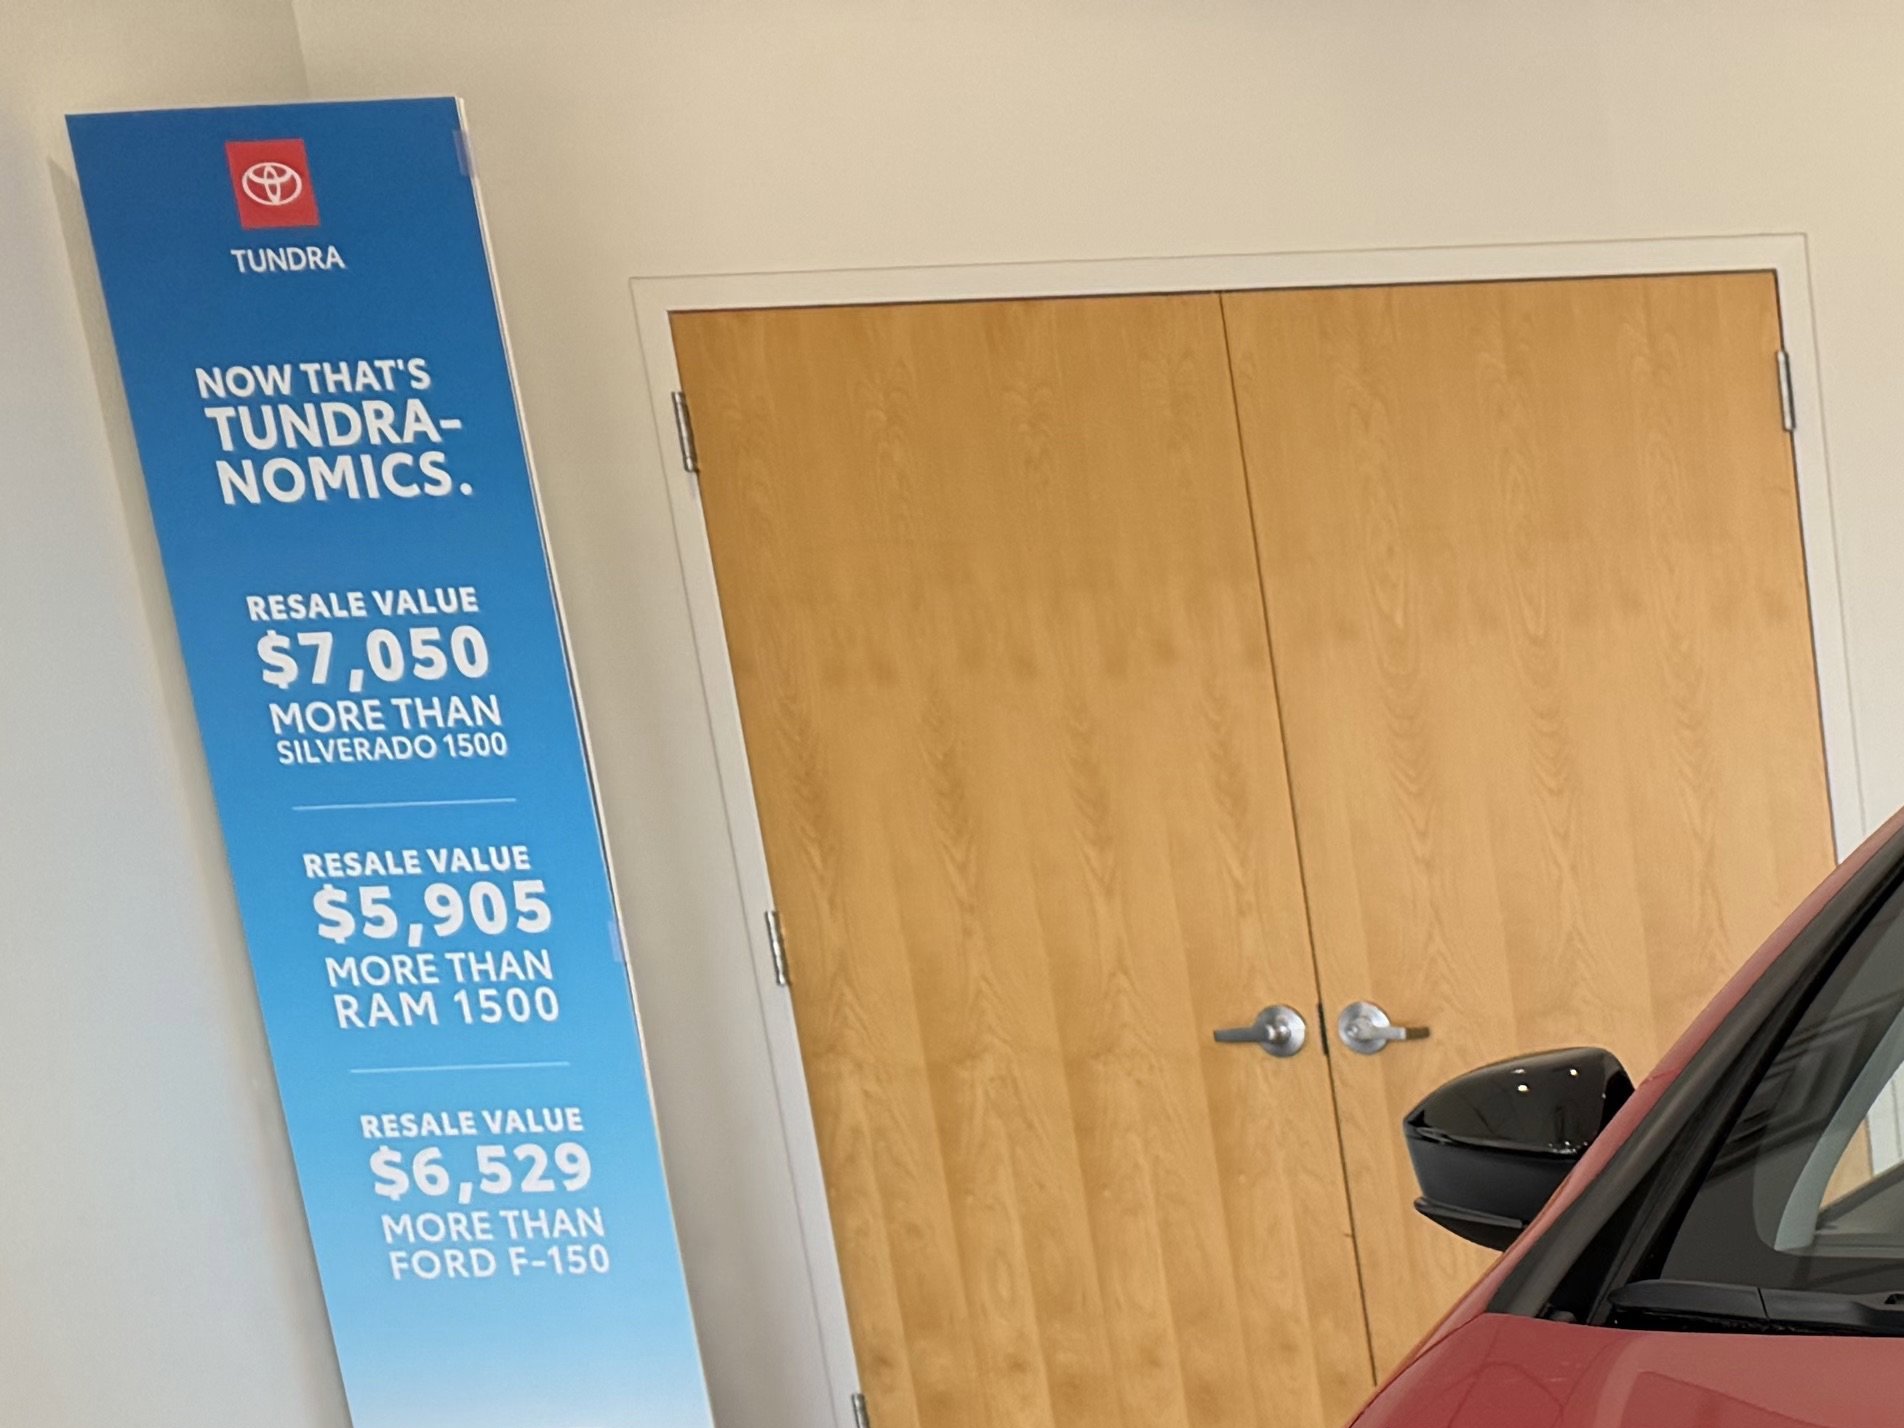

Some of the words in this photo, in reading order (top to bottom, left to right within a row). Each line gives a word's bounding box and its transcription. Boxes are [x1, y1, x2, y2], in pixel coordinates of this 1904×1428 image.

[231, 245, 345, 273] TUNDRA
[195, 364, 292, 399] NOW
[300, 357, 432, 394] THAT'S
[204, 398, 462, 451] TUNDRA-
[216, 451, 473, 505] NOMICS.
[246, 591, 368, 621] RESALE
[371, 586, 479, 616] VALUE
[257, 625, 490, 693] $7,050
[269, 698, 386, 735] MORE
[391, 694, 503, 730] THAN
[277, 734, 438, 765] SILVERADO
[443, 731, 508, 758] 1500
[303, 850, 423, 879] RESALE
[426, 845, 532, 874] VALUE
[313, 879, 552, 948] $5,905
[325, 953, 440, 988] MORE
[445, 949, 554, 983] THAN
[333, 990, 440, 1030] RAM
[454, 986, 559, 1025] 1500
[360, 1110, 478, 1139] RESALE
[481, 1107, 585, 1134] VALUE
[369, 1141, 592, 1205] $6,529
[381, 1210, 495, 1245] MORE
[499, 1206, 606, 1240] THAN
[389, 1248, 497, 1281] FORD
[508, 1243, 610, 1277] F-150
